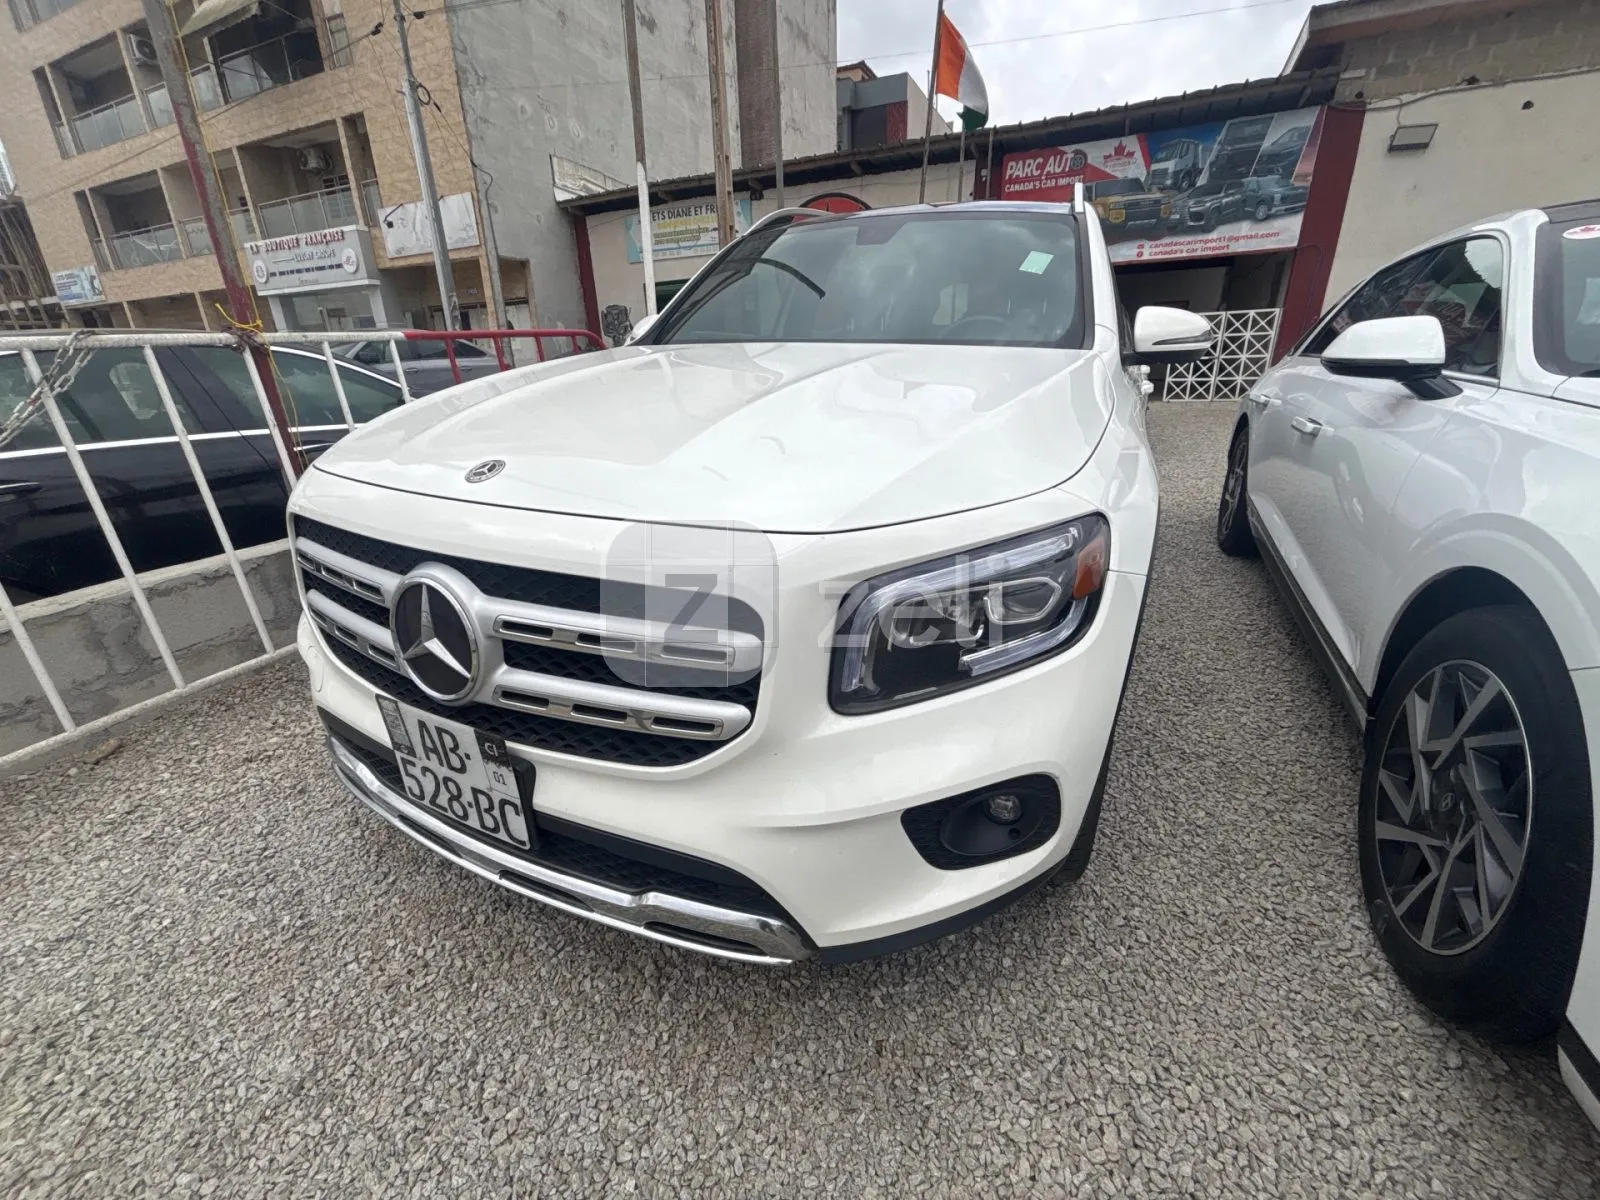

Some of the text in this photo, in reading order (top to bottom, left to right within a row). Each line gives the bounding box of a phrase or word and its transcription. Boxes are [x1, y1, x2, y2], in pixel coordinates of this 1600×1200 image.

[1006, 157, 1043, 180] PARC
[1005, 174, 1084, 192] CANADA'S CAR IMPORT
[652, 211, 666, 221] ETS
[668, 206, 692, 219] DIANE
[694, 205, 705, 216] ET
[1149, 247, 1184, 257] canada's
[1200, 243, 1230, 253] import
